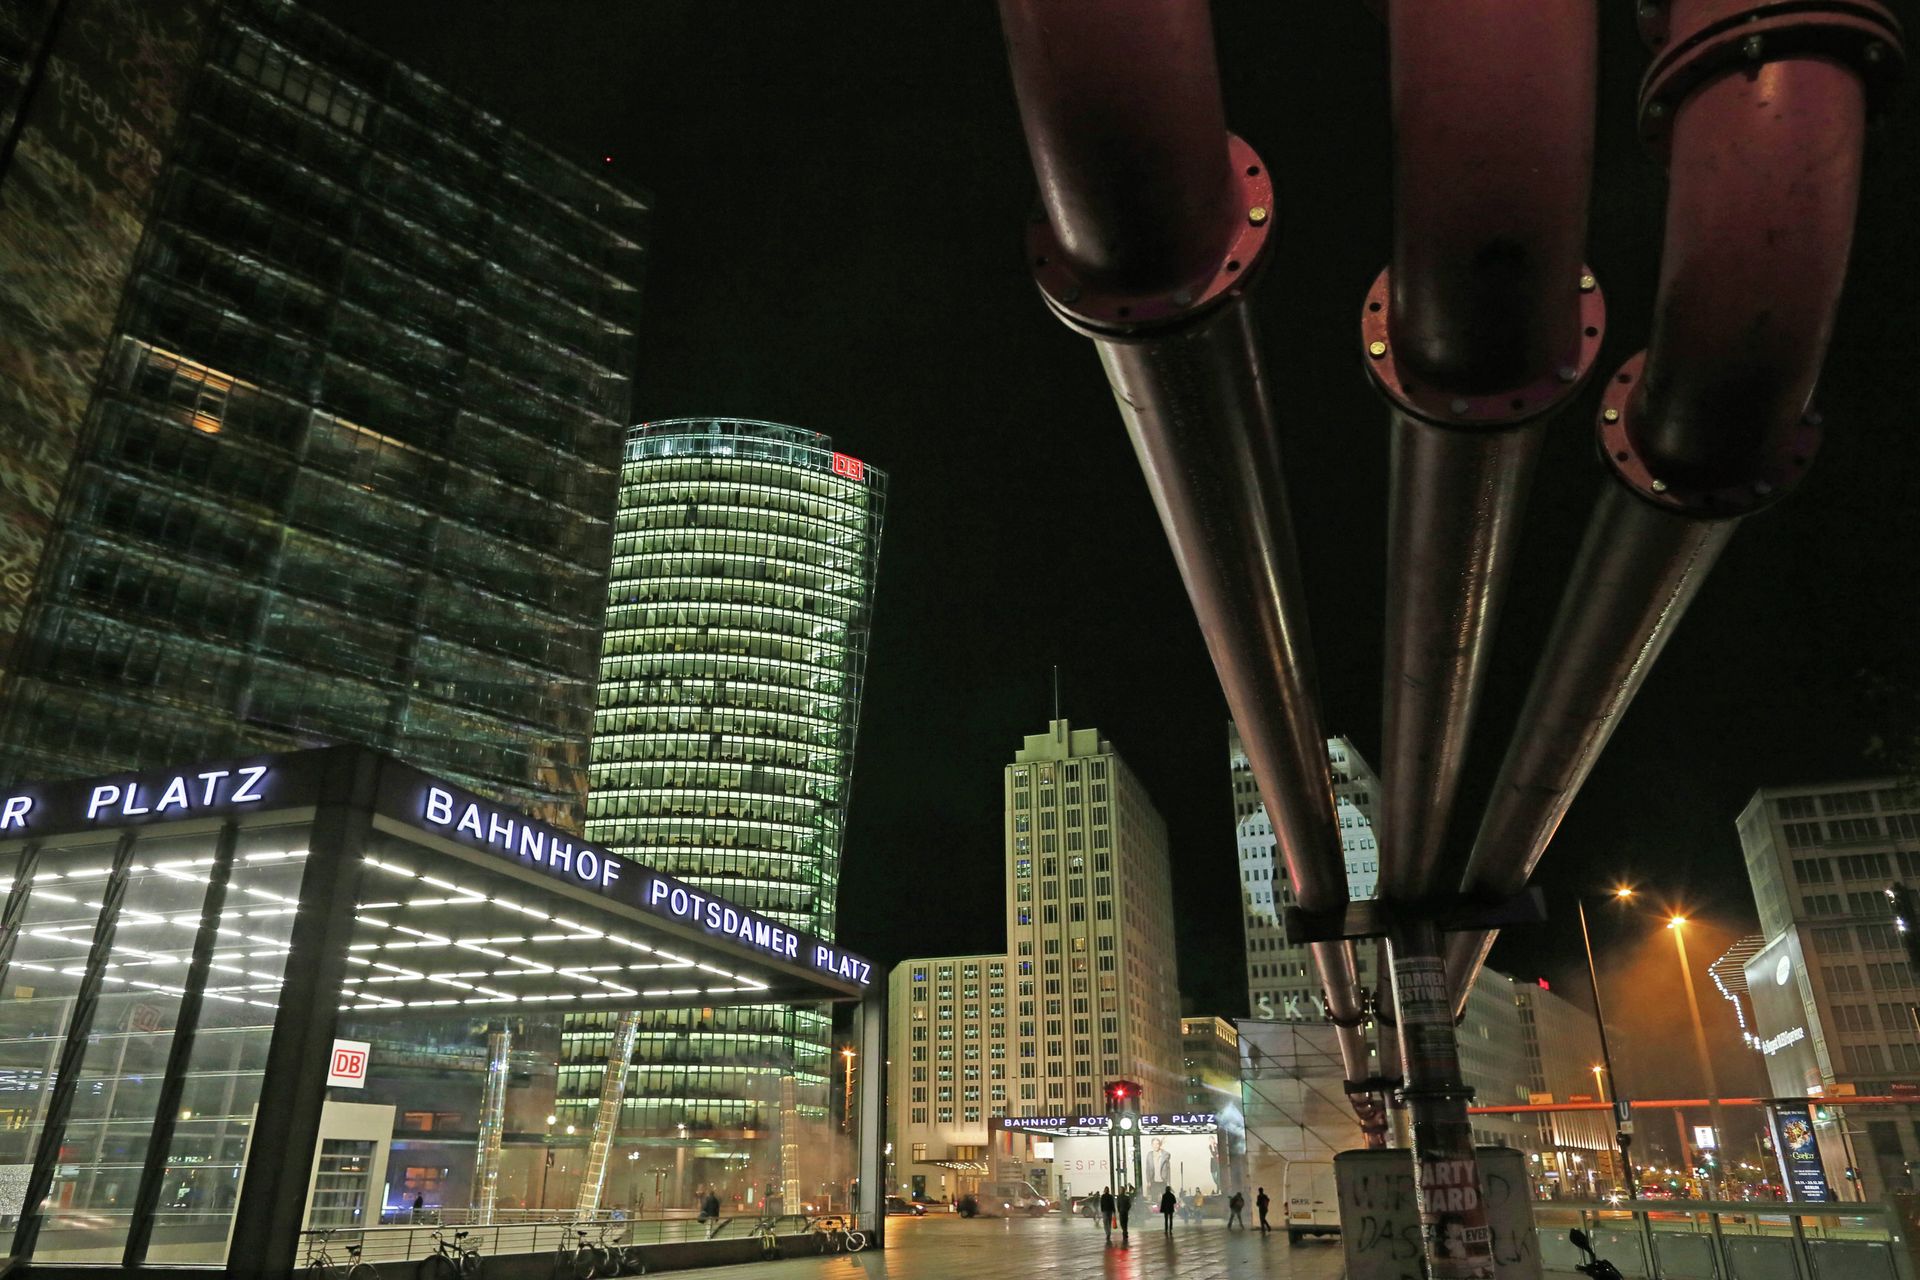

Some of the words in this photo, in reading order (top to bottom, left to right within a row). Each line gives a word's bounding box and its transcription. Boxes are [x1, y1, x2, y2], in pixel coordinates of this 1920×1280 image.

[836, 455, 862, 479] DB
[87, 766, 268, 820] PLATZ
[426, 787, 621, 887] BAHNHOF
[651, 879, 798, 958] POTSDAMER
[816, 945, 871, 984] PLATZ
[335, 1053, 362, 1074] DB
[1004, 1118, 1067, 1127] BAHNHOF
[1172, 1114, 1215, 1123] PLATZ
[1620, 1101, 1629, 1120] U
[1064, 1160, 1124, 1170] ESPR
